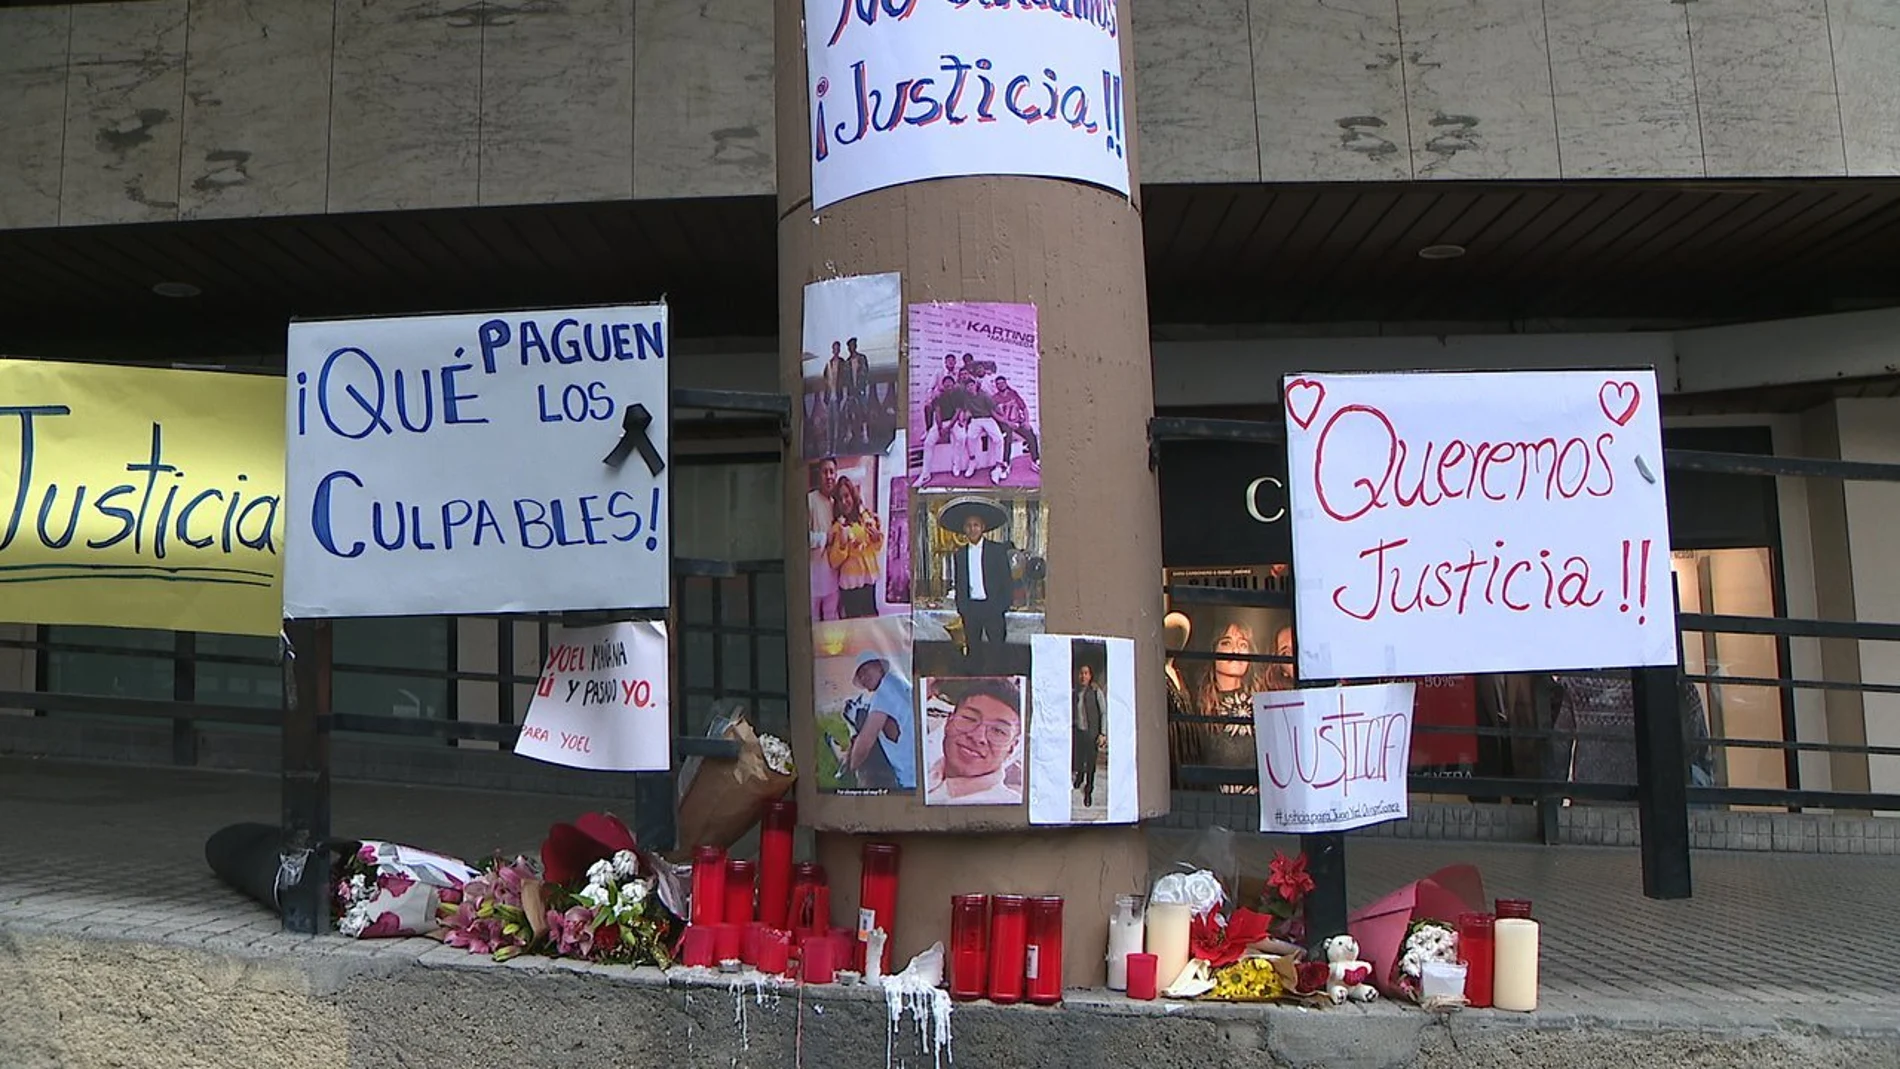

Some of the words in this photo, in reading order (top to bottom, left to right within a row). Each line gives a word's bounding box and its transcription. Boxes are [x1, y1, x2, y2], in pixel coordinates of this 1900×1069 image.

[296, 347, 489, 440] ¡QUÉ
[479, 319, 664, 374] PAGUEN
[538, 381, 615, 422] LOS
[0, 405, 281, 558] Justicia
[1314, 404, 1617, 522] Queremos
[312, 470, 660, 558] CULPABLES!
[547, 644, 586, 672] YOEL
[565, 679, 580, 702] Y
[521, 725, 549, 742] PARA
[560, 732, 591, 753] YOEL
[1263, 693, 1408, 797] JUSTICIA
